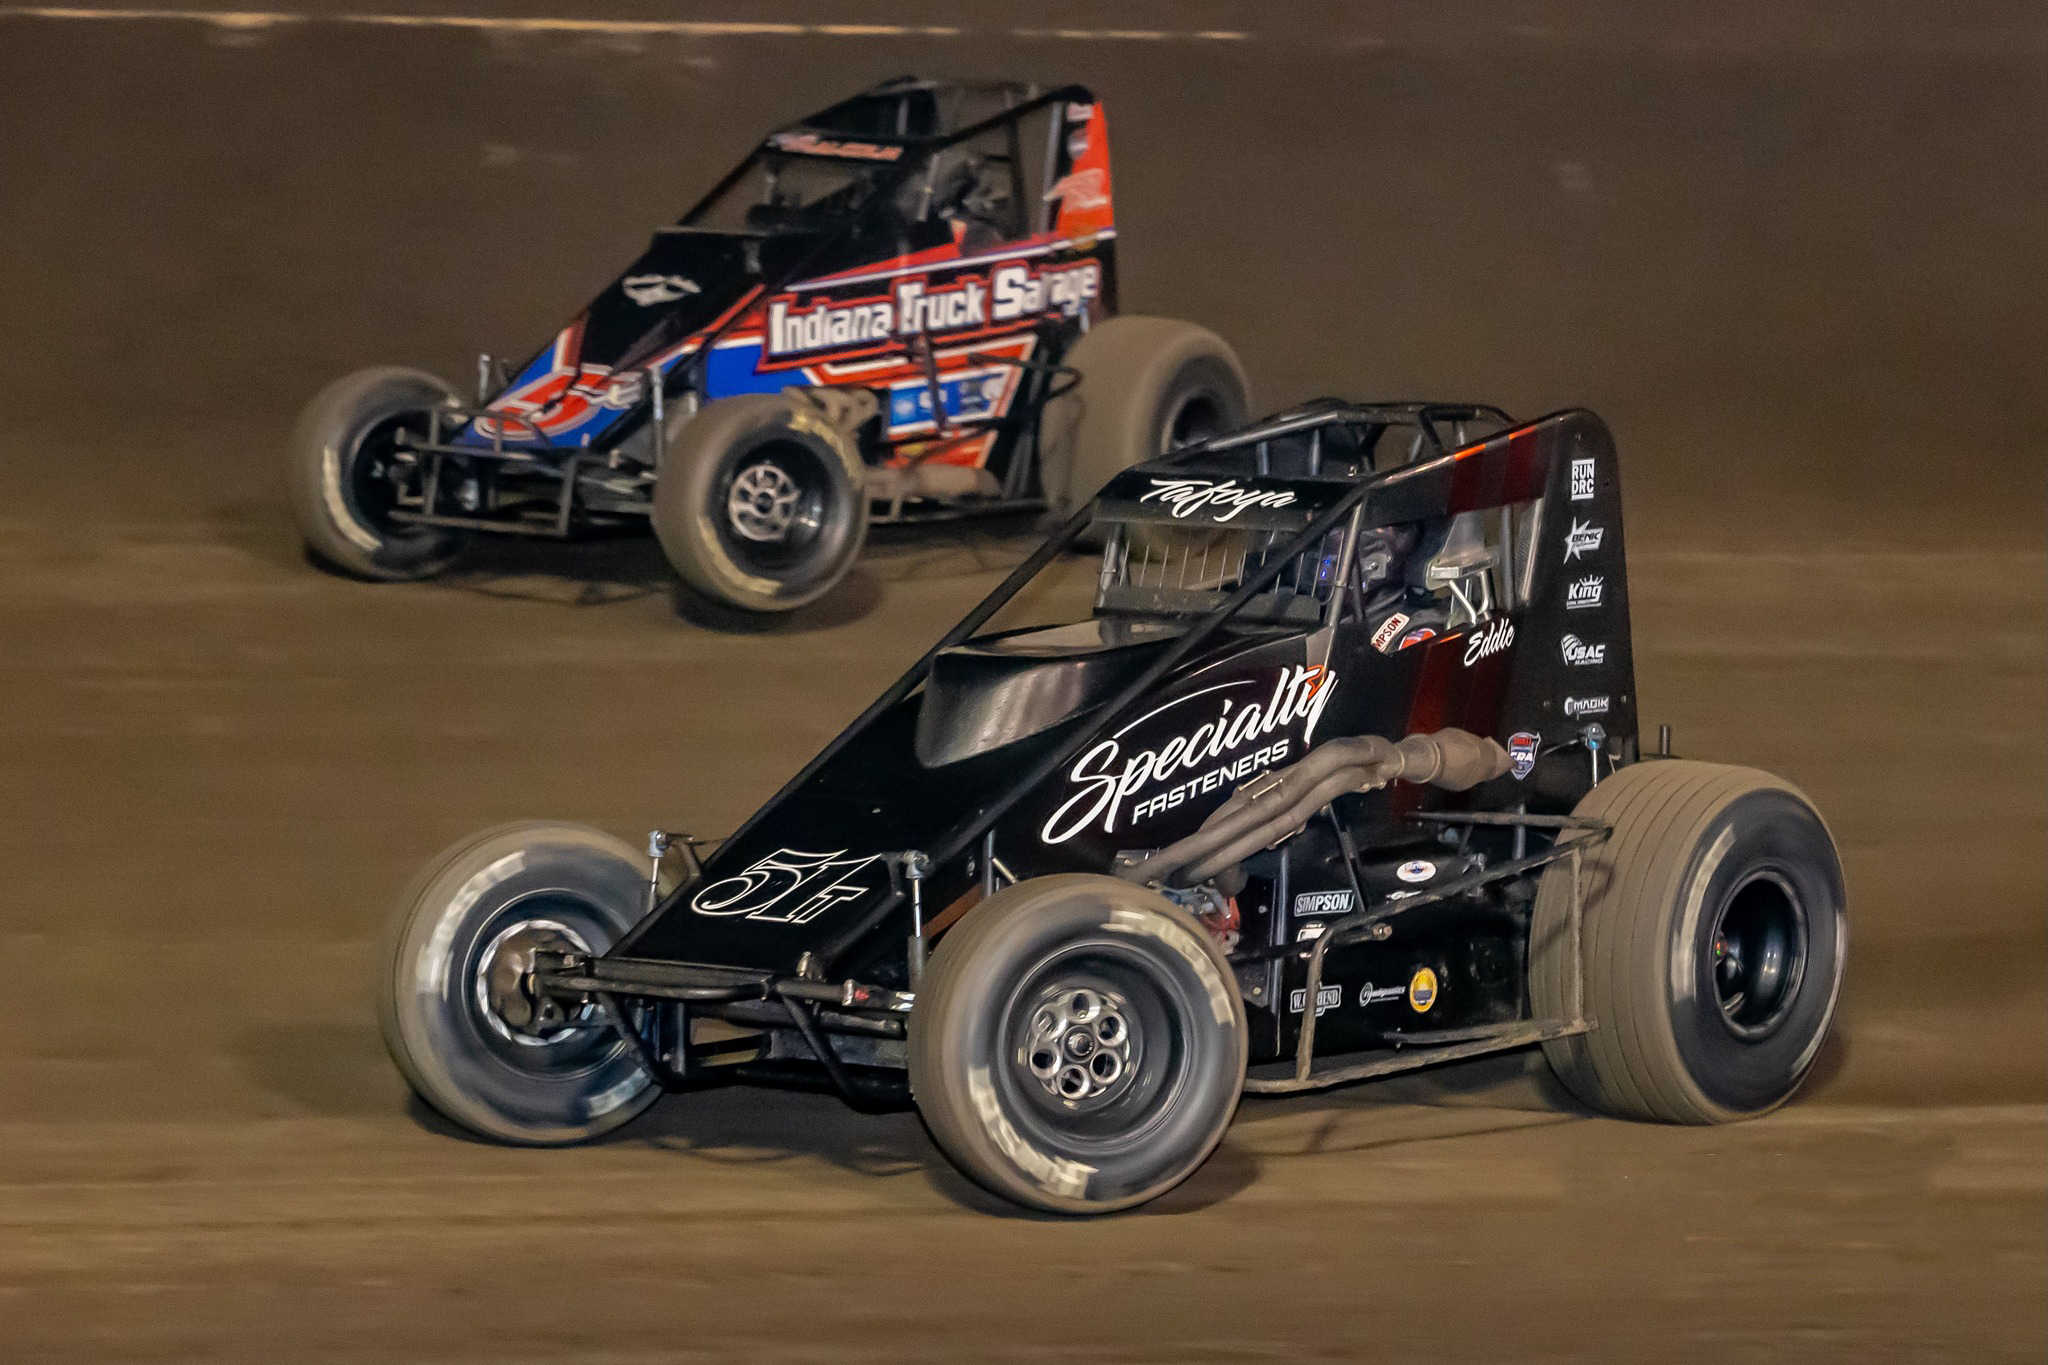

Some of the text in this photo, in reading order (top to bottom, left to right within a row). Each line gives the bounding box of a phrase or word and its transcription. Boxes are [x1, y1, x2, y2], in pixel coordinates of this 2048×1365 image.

[769, 301, 894, 355] Indiana
[898, 281, 987, 334] Truck
[1571, 478, 1594, 495] DRC
[1572, 464, 1594, 480] RUN
[1140, 479, 1297, 523] Tafoya
[1568, 582, 1603, 603] King
[1464, 617, 1515, 667] Eddie
[1568, 643, 1606, 661] USAC
[1041, 664, 1339, 844] Specialty
[1131, 738, 1290, 826] FASTENERS
[1296, 893, 1350, 914] SIMPSON
